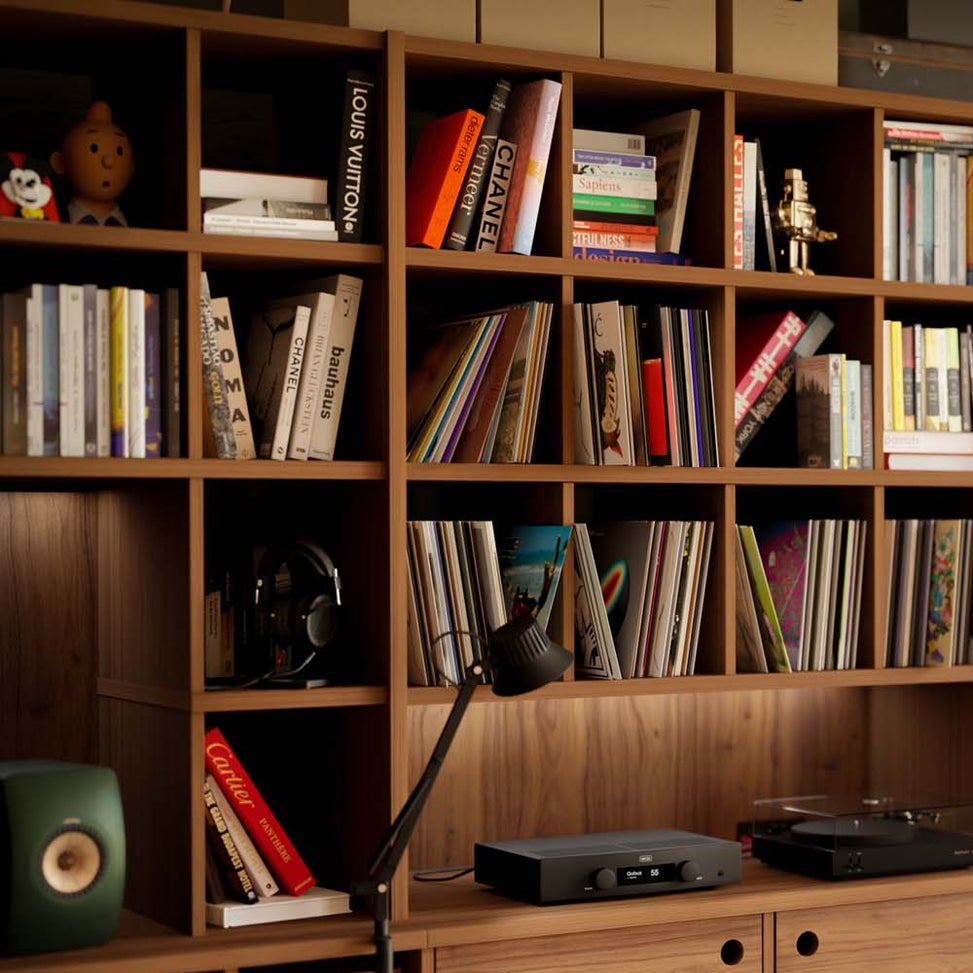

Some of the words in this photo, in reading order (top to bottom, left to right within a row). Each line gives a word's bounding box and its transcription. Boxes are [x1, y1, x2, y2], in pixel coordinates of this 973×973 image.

[349, 87, 368, 140] LOUIS
[461, 115, 480, 149] dieter
[342, 144, 365, 223] VUITTON
[452, 146, 469, 174] rams
[460, 134, 498, 216] Vermeer
[578, 177, 622, 193] Sapiens
[478, 145, 514, 250] CHANEL
[213, 315, 247, 423] NOMA
[286, 336, 304, 393] CHANEL
[320, 345, 346, 420] bauhaus
[205, 742, 256, 809] Cartier
[236, 867, 253, 894] HOTEL
